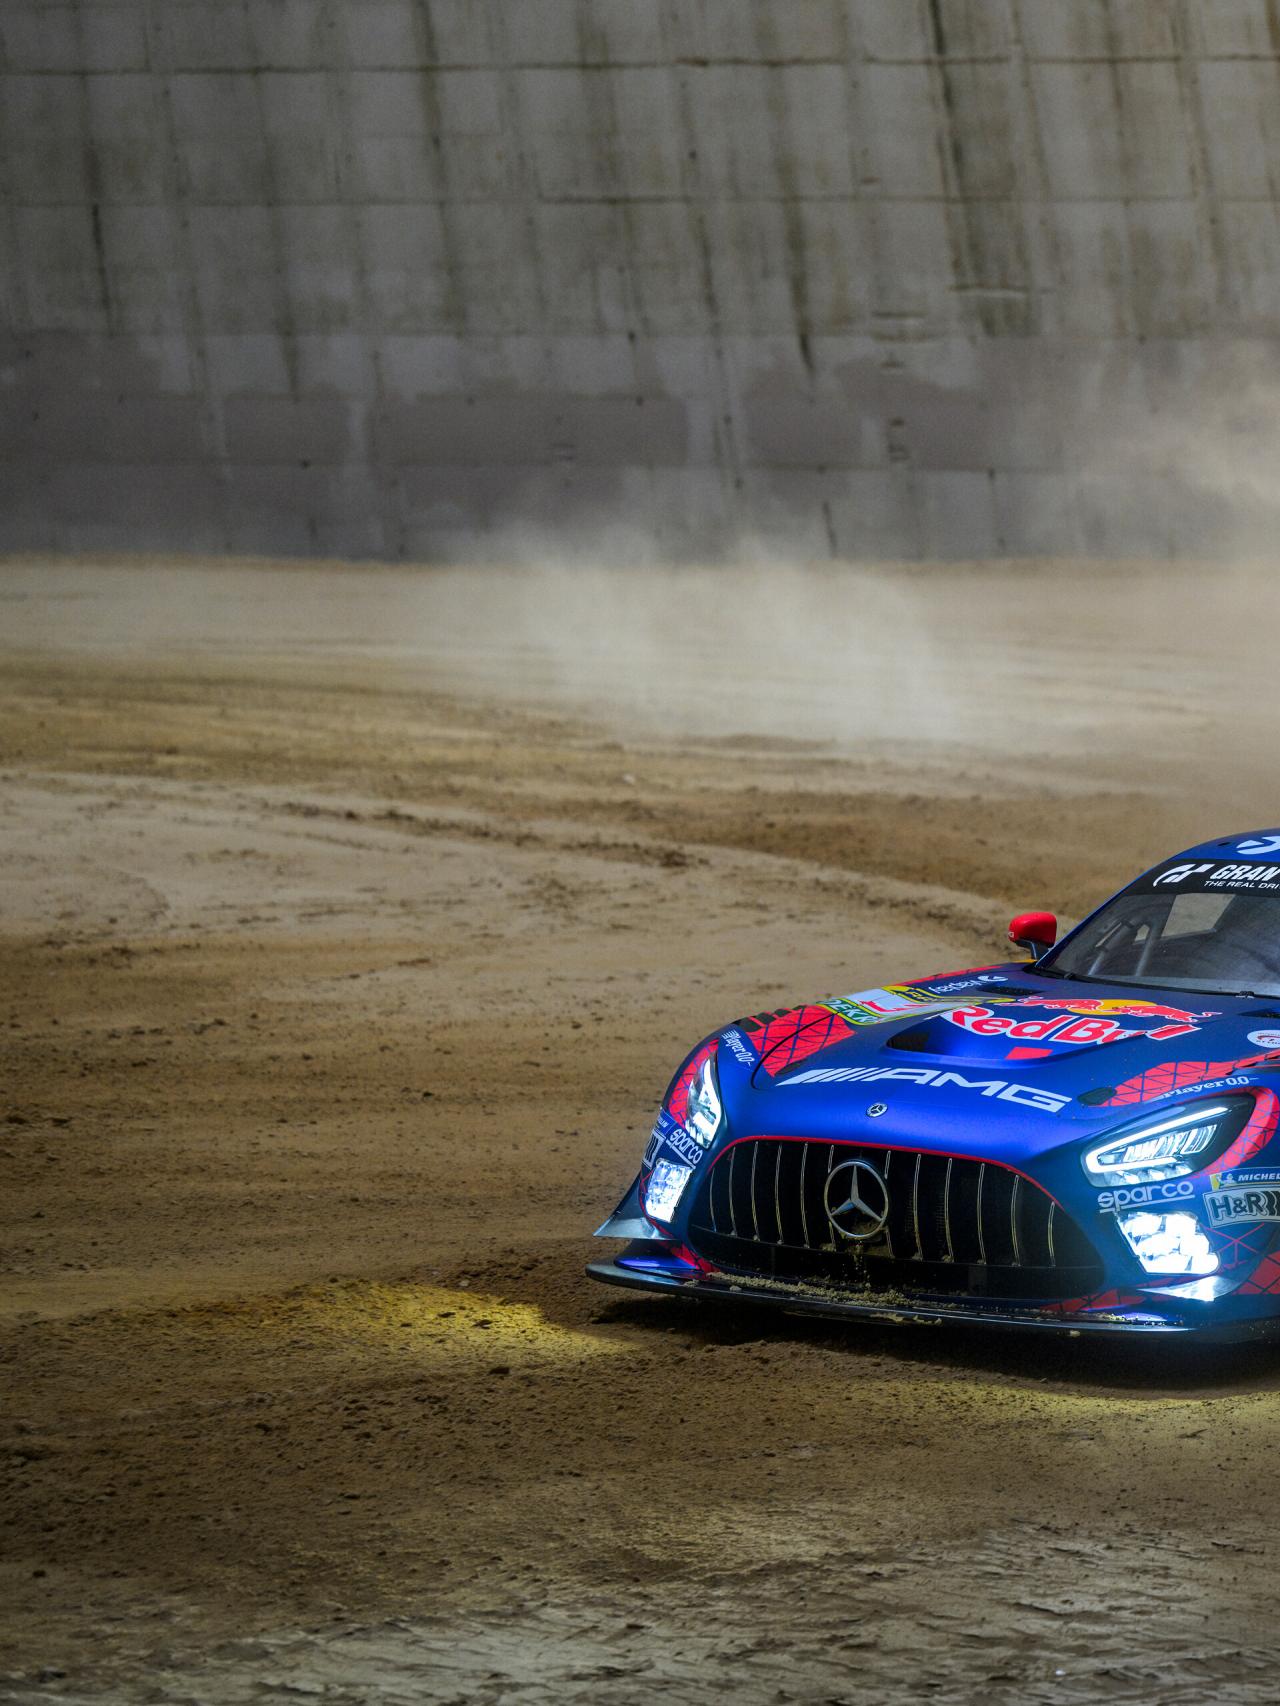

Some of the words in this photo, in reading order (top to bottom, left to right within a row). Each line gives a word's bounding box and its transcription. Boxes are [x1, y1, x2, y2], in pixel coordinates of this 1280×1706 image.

[1226, 881, 1255, 889] REAL
[944, 1004, 1073, 1041] Red
[864, 1067, 1073, 1113] AMG
[669, 1128, 703, 1165] sparco
[1097, 1181, 1194, 1212] sparco
[1210, 1191, 1267, 1220] H&R
